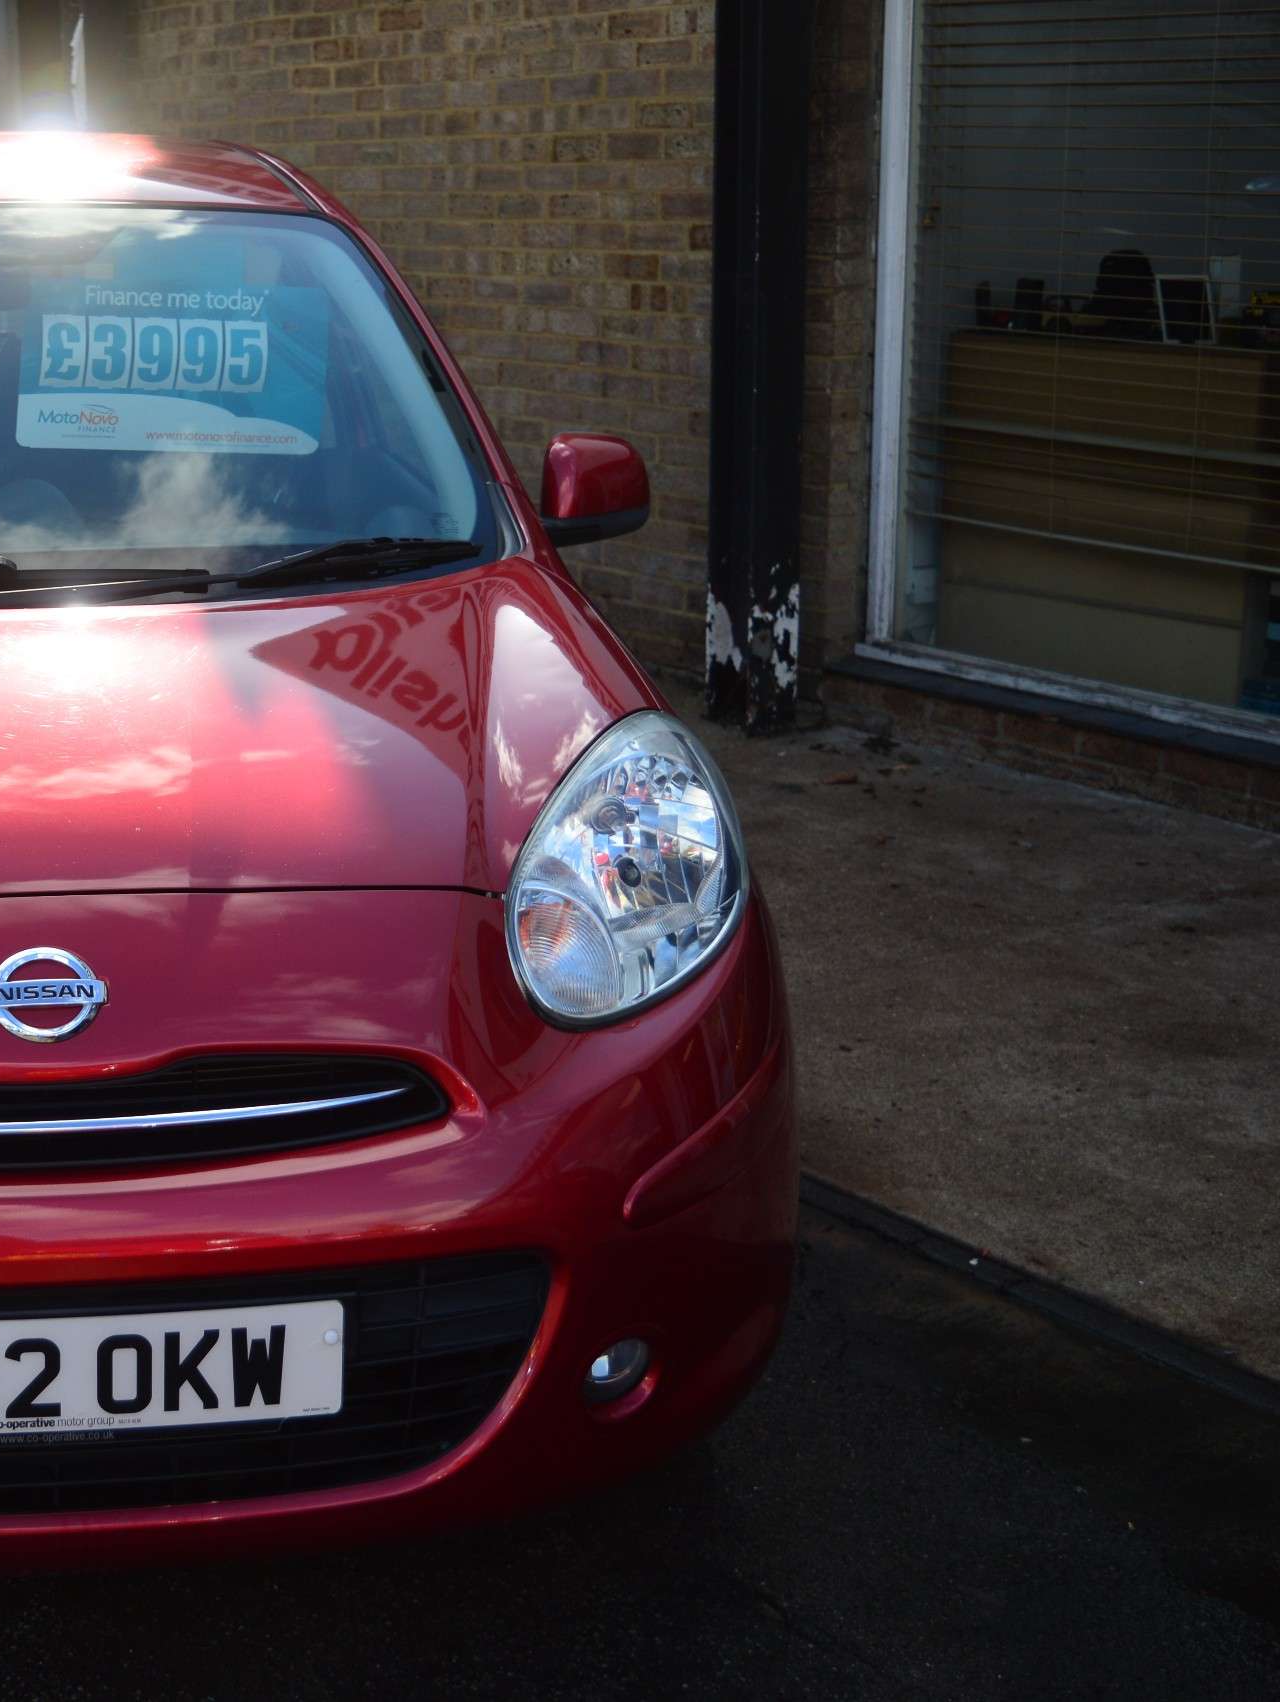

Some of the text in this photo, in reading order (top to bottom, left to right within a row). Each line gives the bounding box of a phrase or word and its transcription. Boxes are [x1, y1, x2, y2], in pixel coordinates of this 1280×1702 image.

[85, 286, 162, 308] Finance
[167, 293, 201, 309] me
[45, 322, 264, 386] £3995
[37, 409, 119, 426] MotoNovo
[77, 425, 117, 433] FINANCE
[144, 431, 297, 445] www.motonovofinance.com
[96, 1323, 287, 1415] OKW
[57, 1416, 85, 1427] motor
[87, 1415, 115, 1427] group
[0, 1430, 115, 1445] www.co-operative.co.uk
